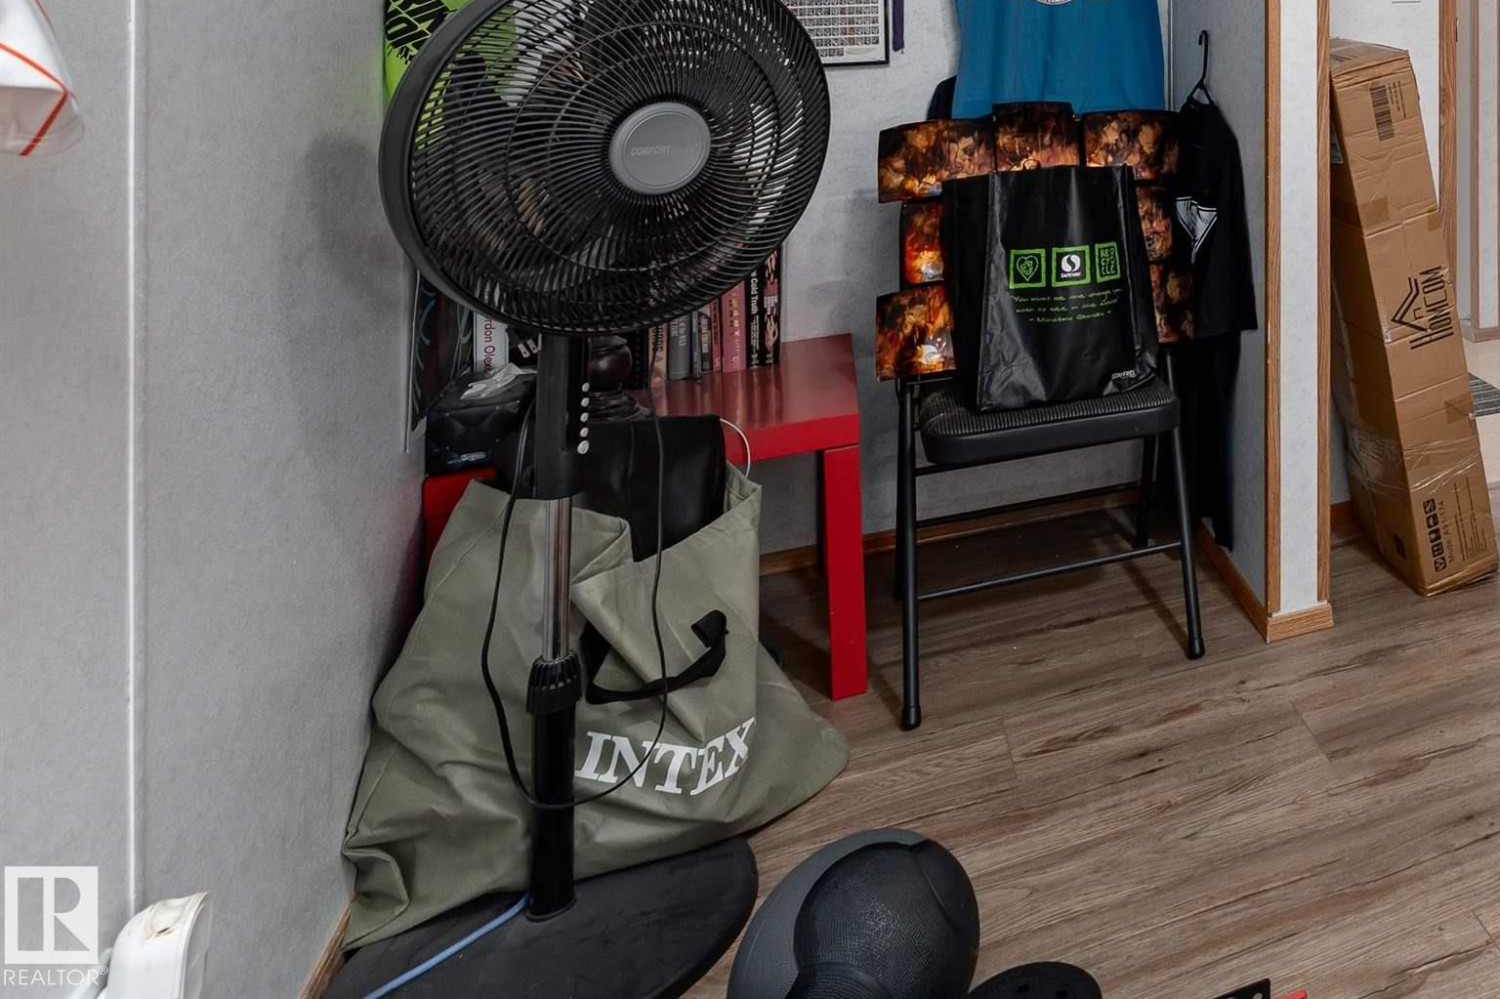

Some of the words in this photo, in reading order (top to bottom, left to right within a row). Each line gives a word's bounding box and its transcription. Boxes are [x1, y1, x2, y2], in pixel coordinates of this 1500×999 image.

[750, 278, 759, 298] Cold
[750, 297, 759, 315] Truth
[575, 716, 755, 796] INTEX
